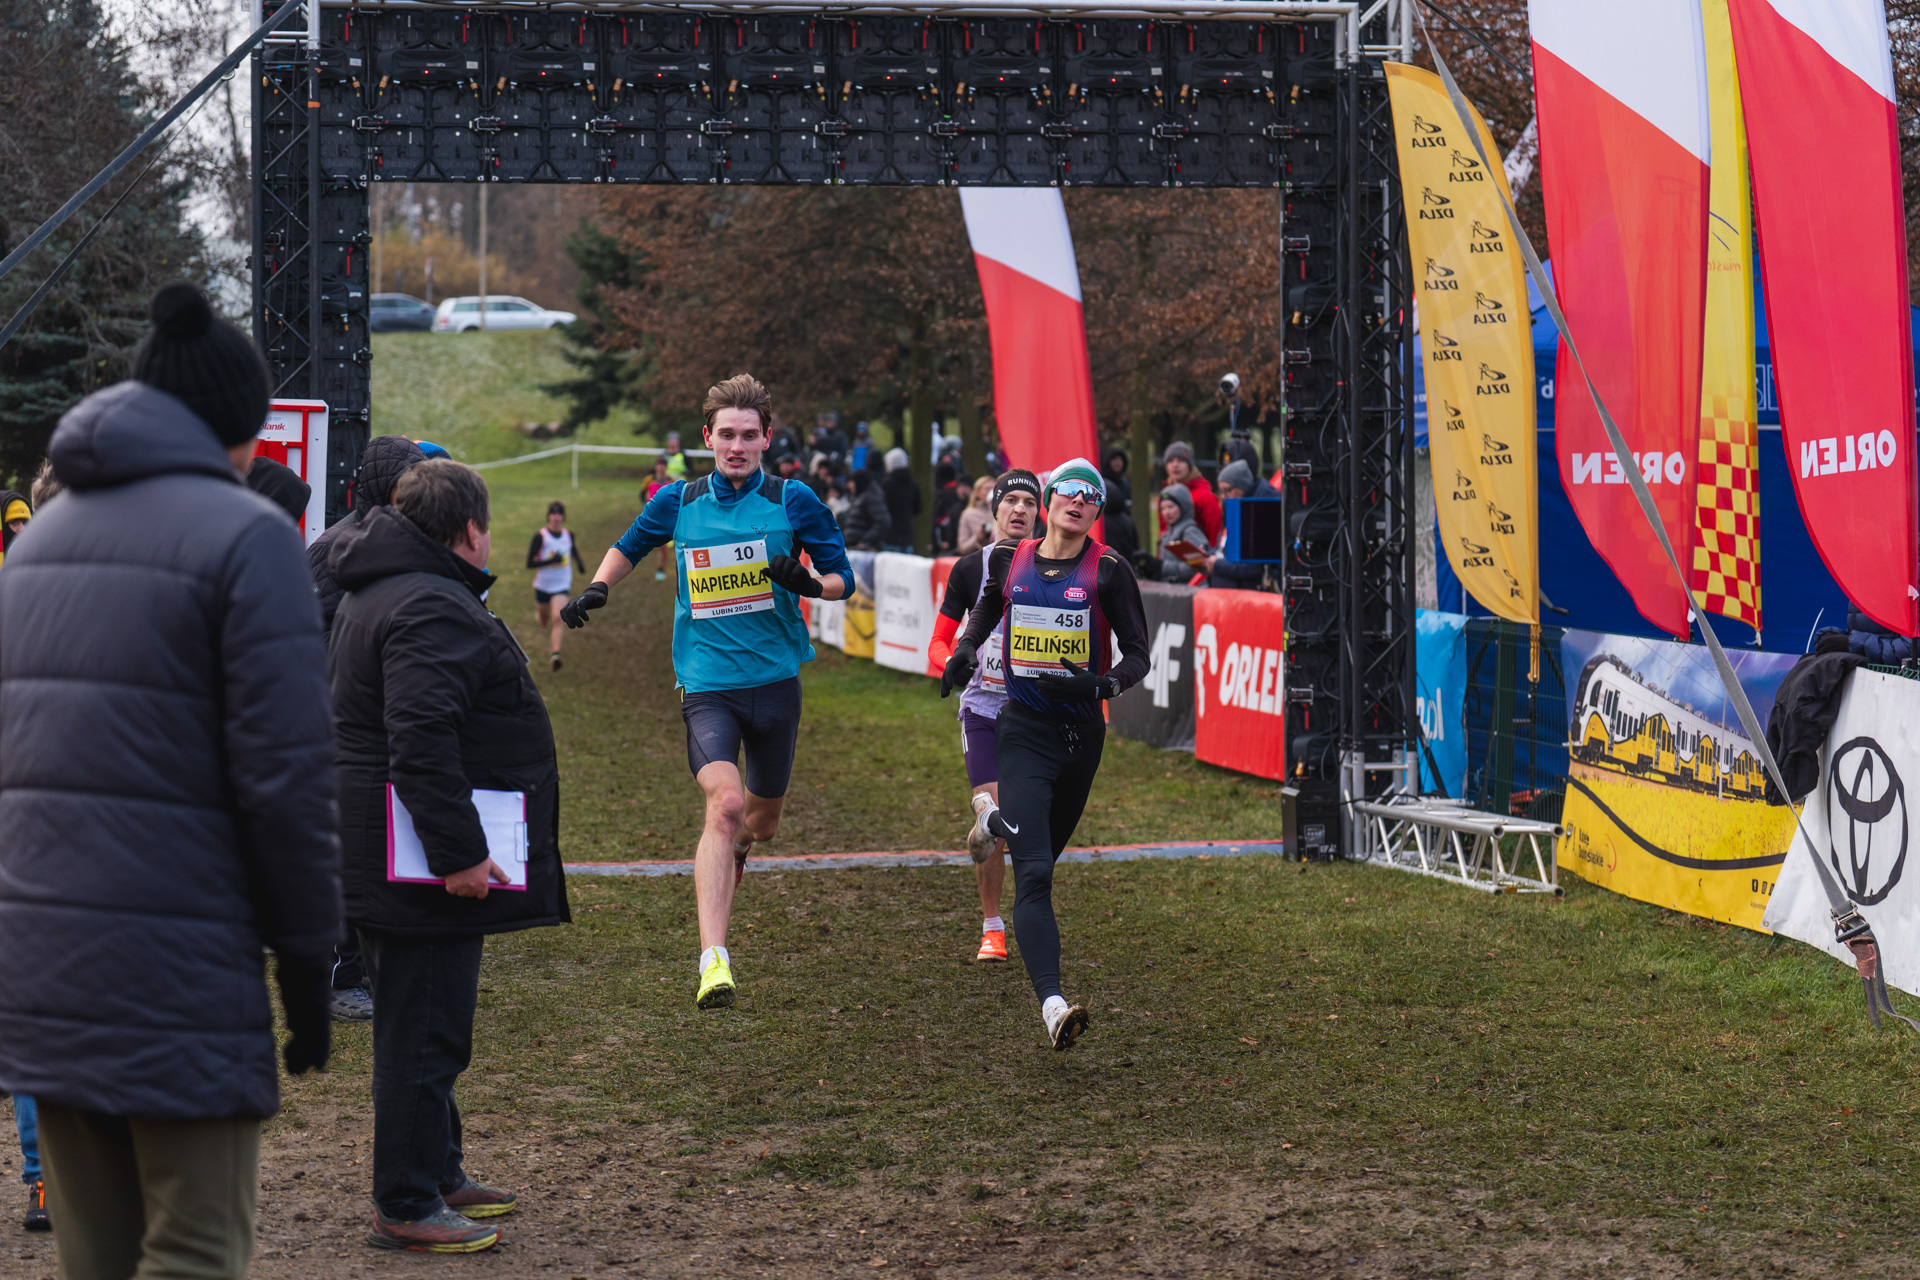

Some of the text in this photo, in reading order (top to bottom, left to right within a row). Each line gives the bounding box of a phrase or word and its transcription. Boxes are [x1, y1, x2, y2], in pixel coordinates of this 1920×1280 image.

[1007, 477, 1038, 493] RUNNING
[734, 546, 754, 561] 10
[691, 570, 769, 594] NAPIERAŁA
[712, 604, 753, 616] LUBIN 2025
[1055, 613, 1083, 628] 458
[1014, 635, 1086, 655] ZIELIŃSKI
[986, 657, 1003, 671] KA
[1143, 621, 1186, 708] 4F
